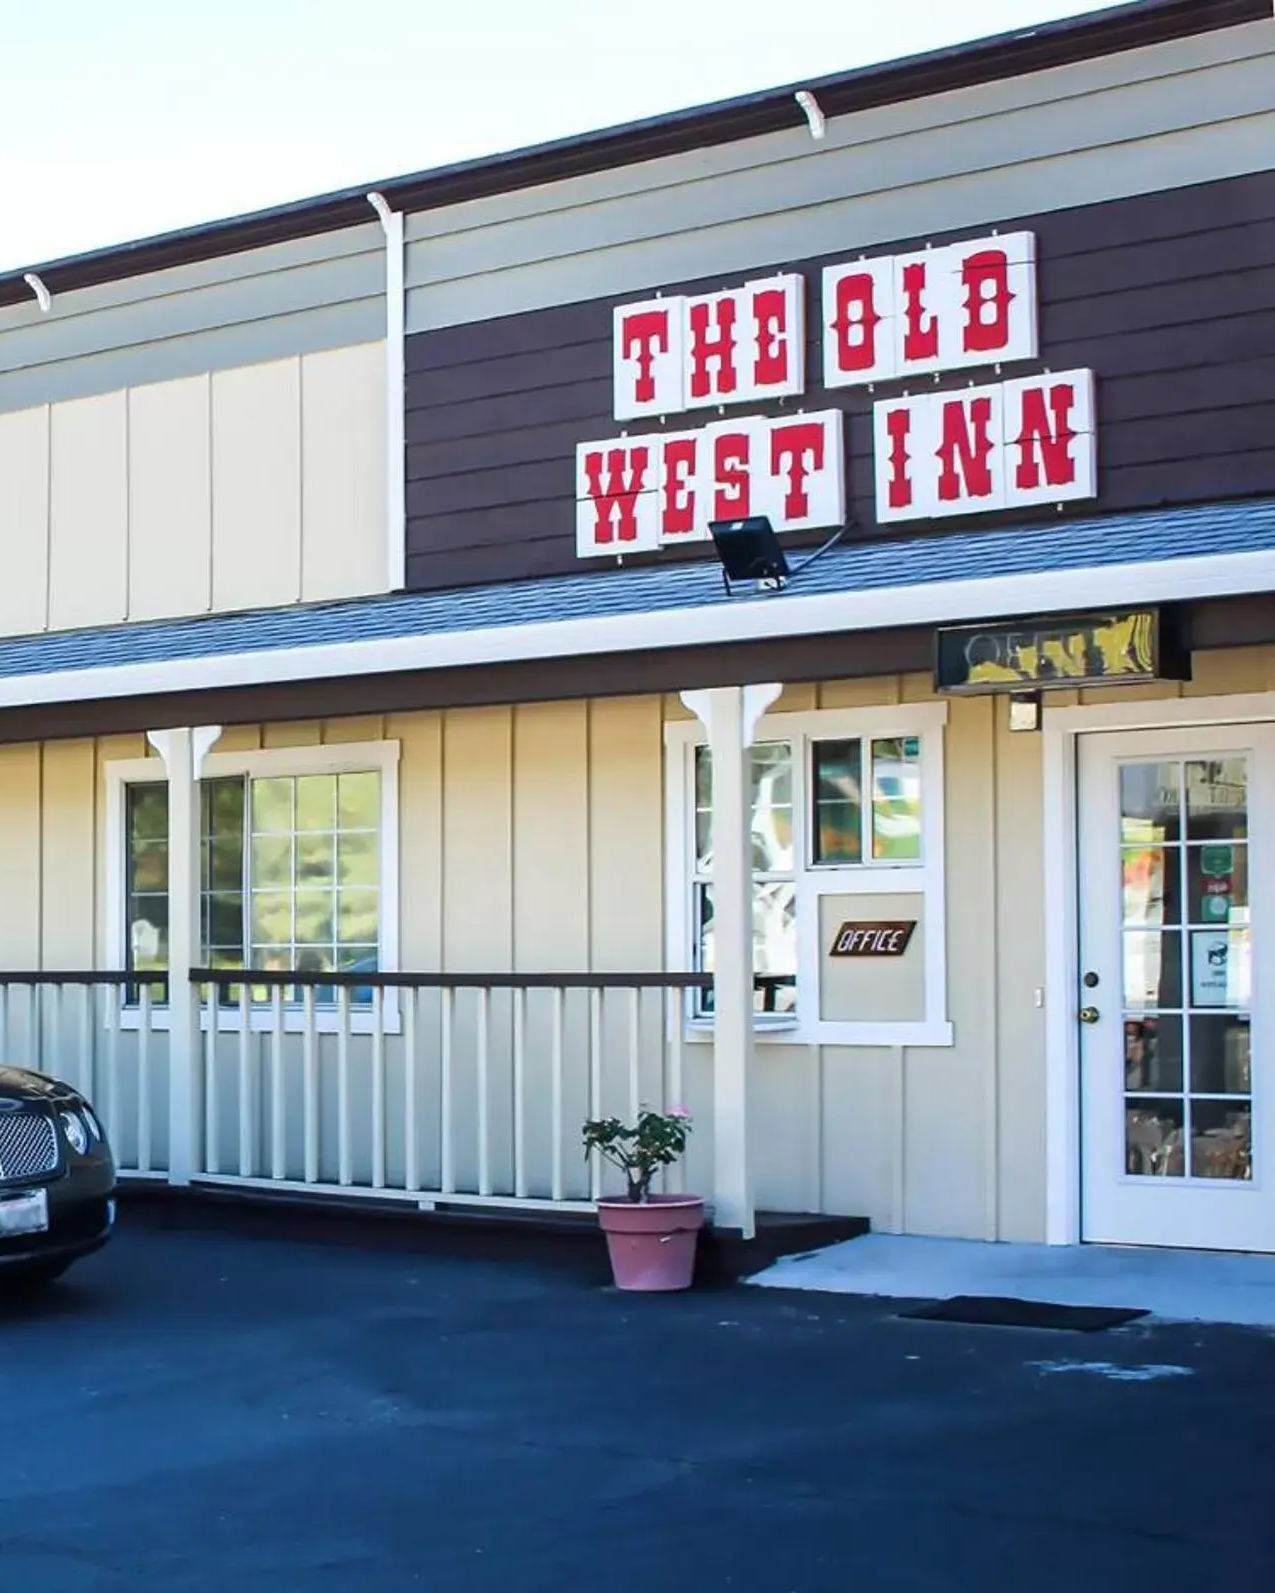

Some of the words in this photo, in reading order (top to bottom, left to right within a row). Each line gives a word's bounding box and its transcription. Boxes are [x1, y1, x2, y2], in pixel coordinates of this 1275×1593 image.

[622, 290, 787, 402] THE
[830, 250, 1015, 371] OLD
[585, 423, 824, 543] WEST
[886, 384, 1076, 508] INN
[837, 929, 903, 951] OFFICE
